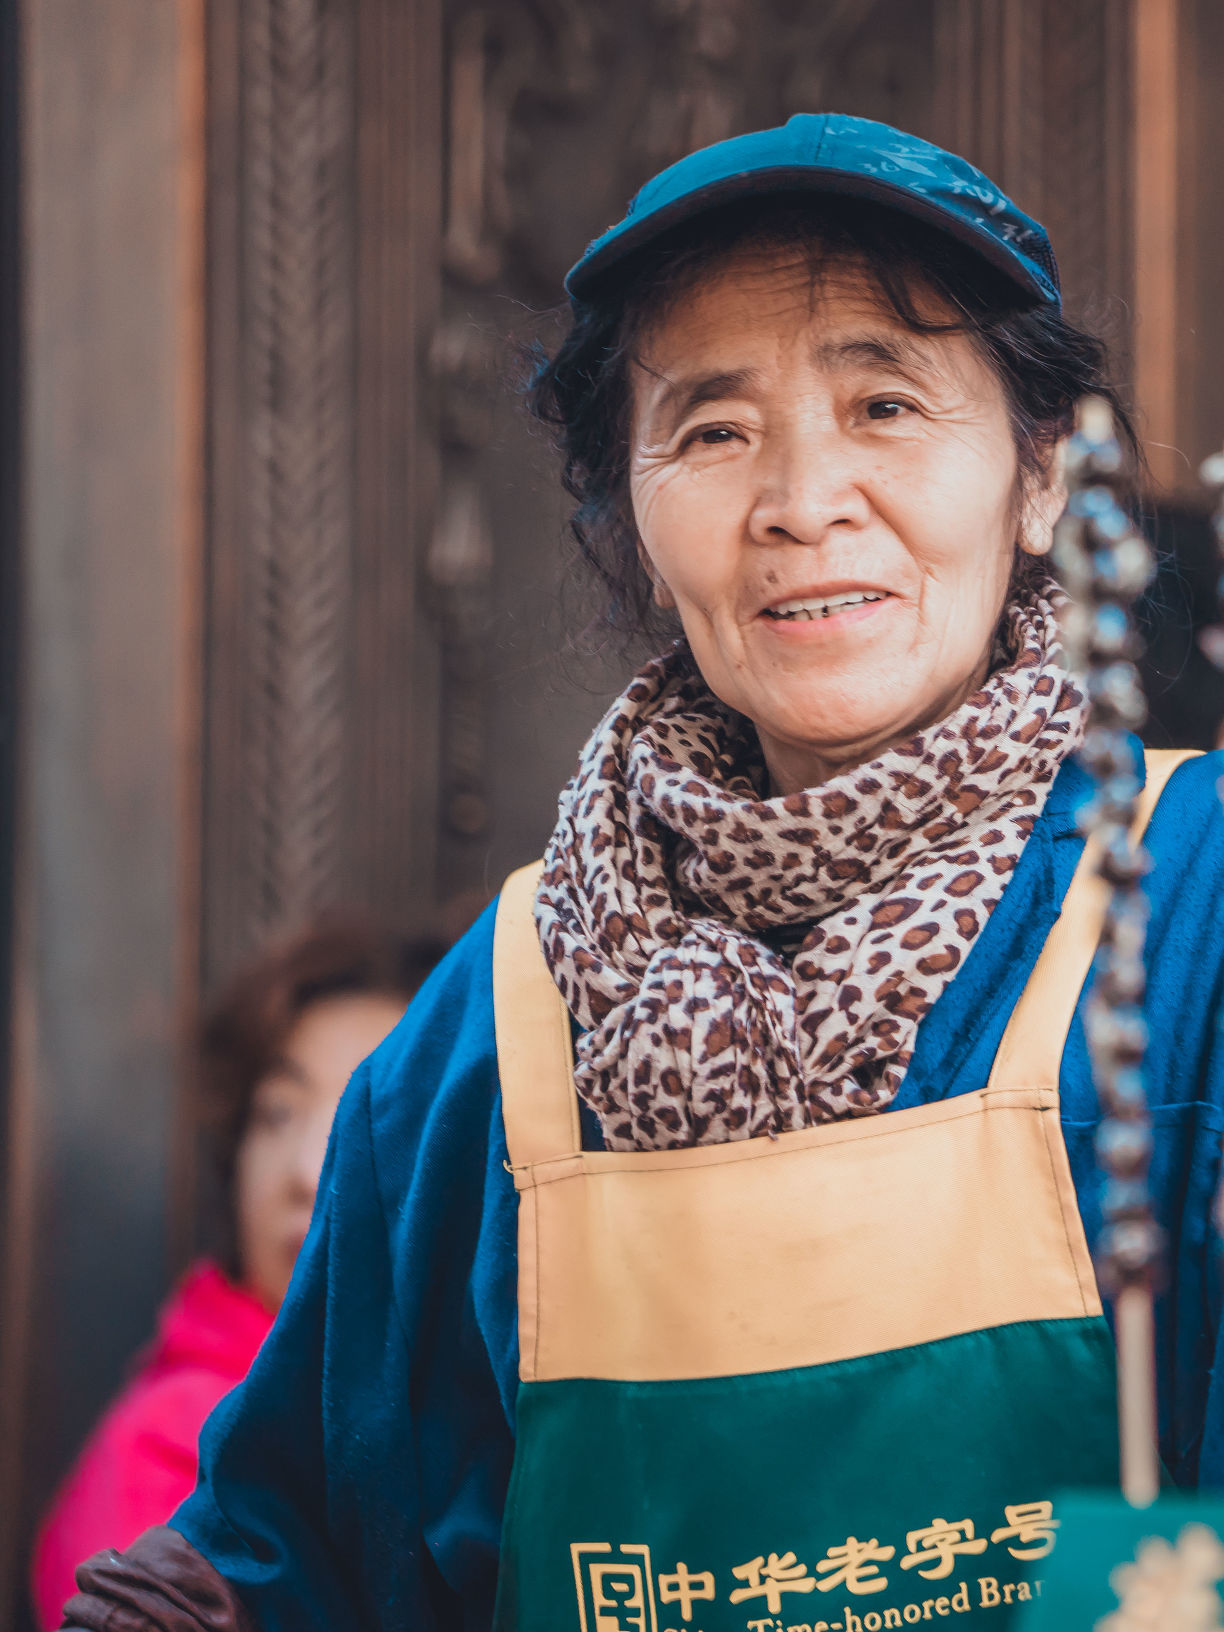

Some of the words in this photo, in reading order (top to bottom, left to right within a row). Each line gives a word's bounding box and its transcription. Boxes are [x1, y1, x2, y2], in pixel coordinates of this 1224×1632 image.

[657, 1500, 1061, 1622] 中华老字号
